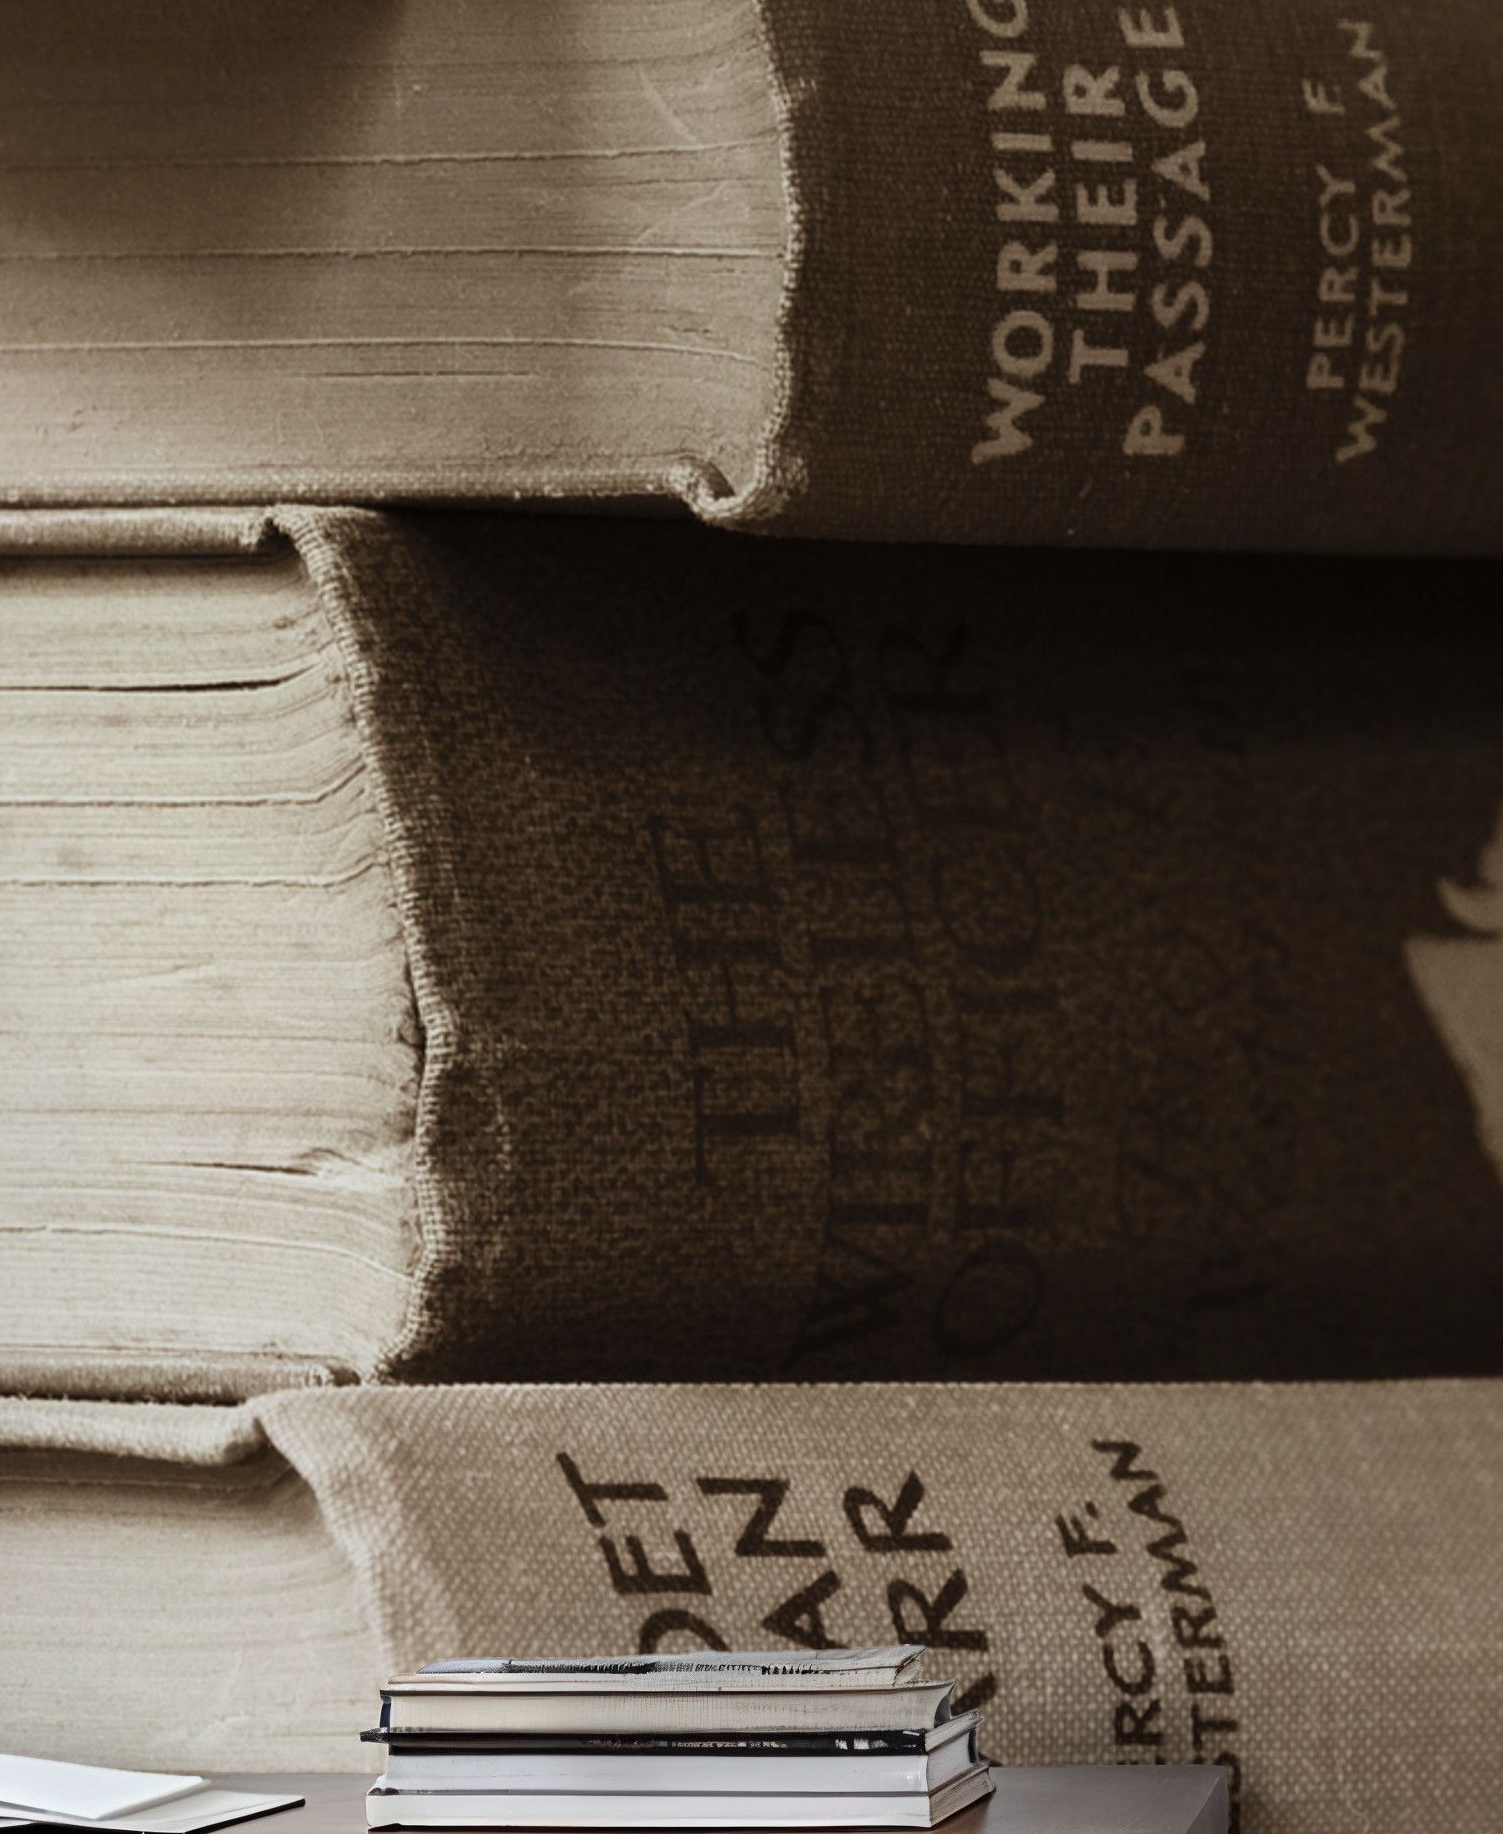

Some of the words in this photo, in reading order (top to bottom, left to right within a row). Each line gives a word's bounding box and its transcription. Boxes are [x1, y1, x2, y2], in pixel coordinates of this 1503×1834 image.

[1061, 64, 1138, 384] THEIR
[1117, 6, 1214, 456] PASSAGE
[1306, 165, 1360, 390] PERCY
[1335, 18, 1412, 464] WESTERMAN
[648, 814, 800, 1187] THE
[1055, 1500, 1118, 1557] F.
